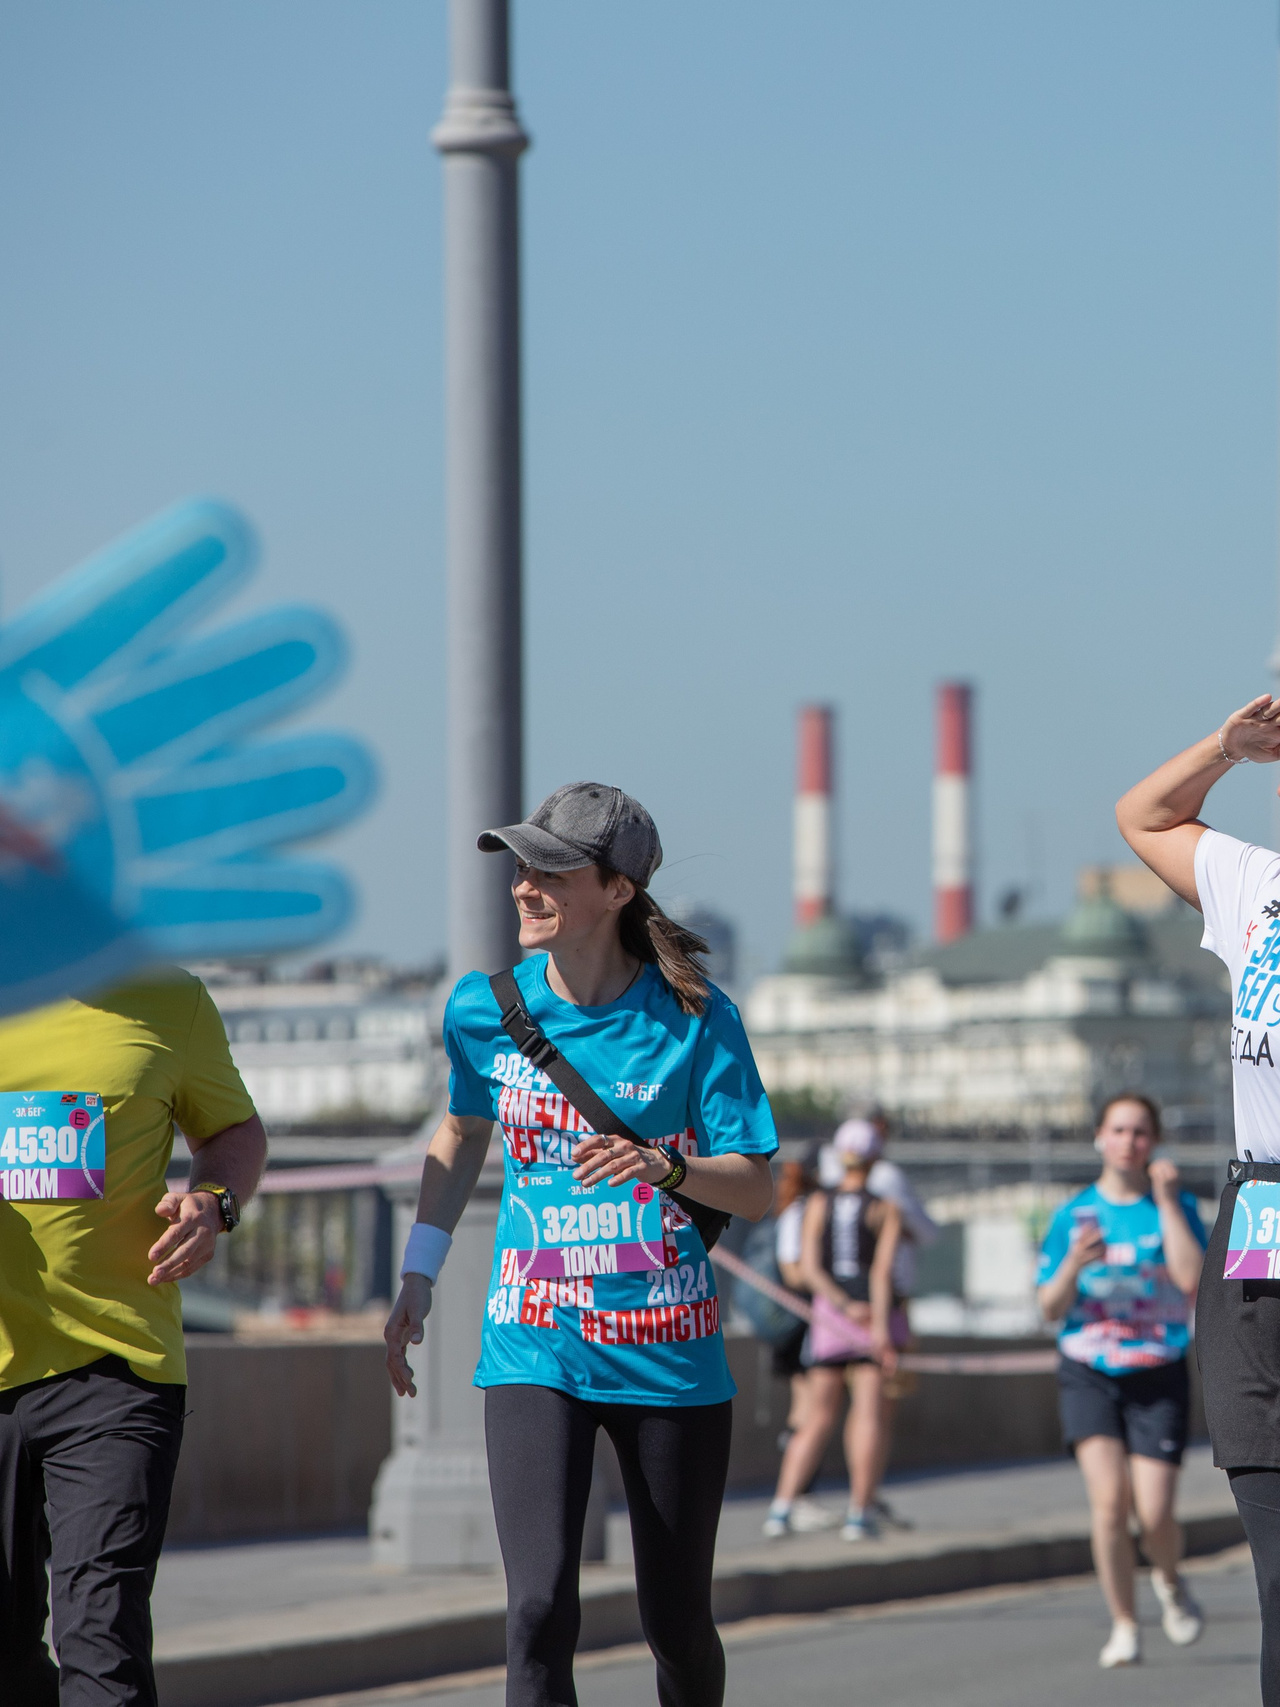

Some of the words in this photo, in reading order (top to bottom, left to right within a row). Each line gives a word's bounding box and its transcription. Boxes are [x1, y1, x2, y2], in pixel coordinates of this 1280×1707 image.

[1231, 1025, 1275, 1067] ГДА
[490, 1053, 552, 1091] 2024
[75, 1112, 85, 1126] E
[0, 1126, 77, 1164] 4530
[531, 1176, 553, 1186] ПСБ
[638, 1186, 649, 1201] E
[542, 1201, 632, 1243] 32091
[646, 1261, 709, 1307] 2024
[488, 1287, 560, 1330] #ЗАБЕ
